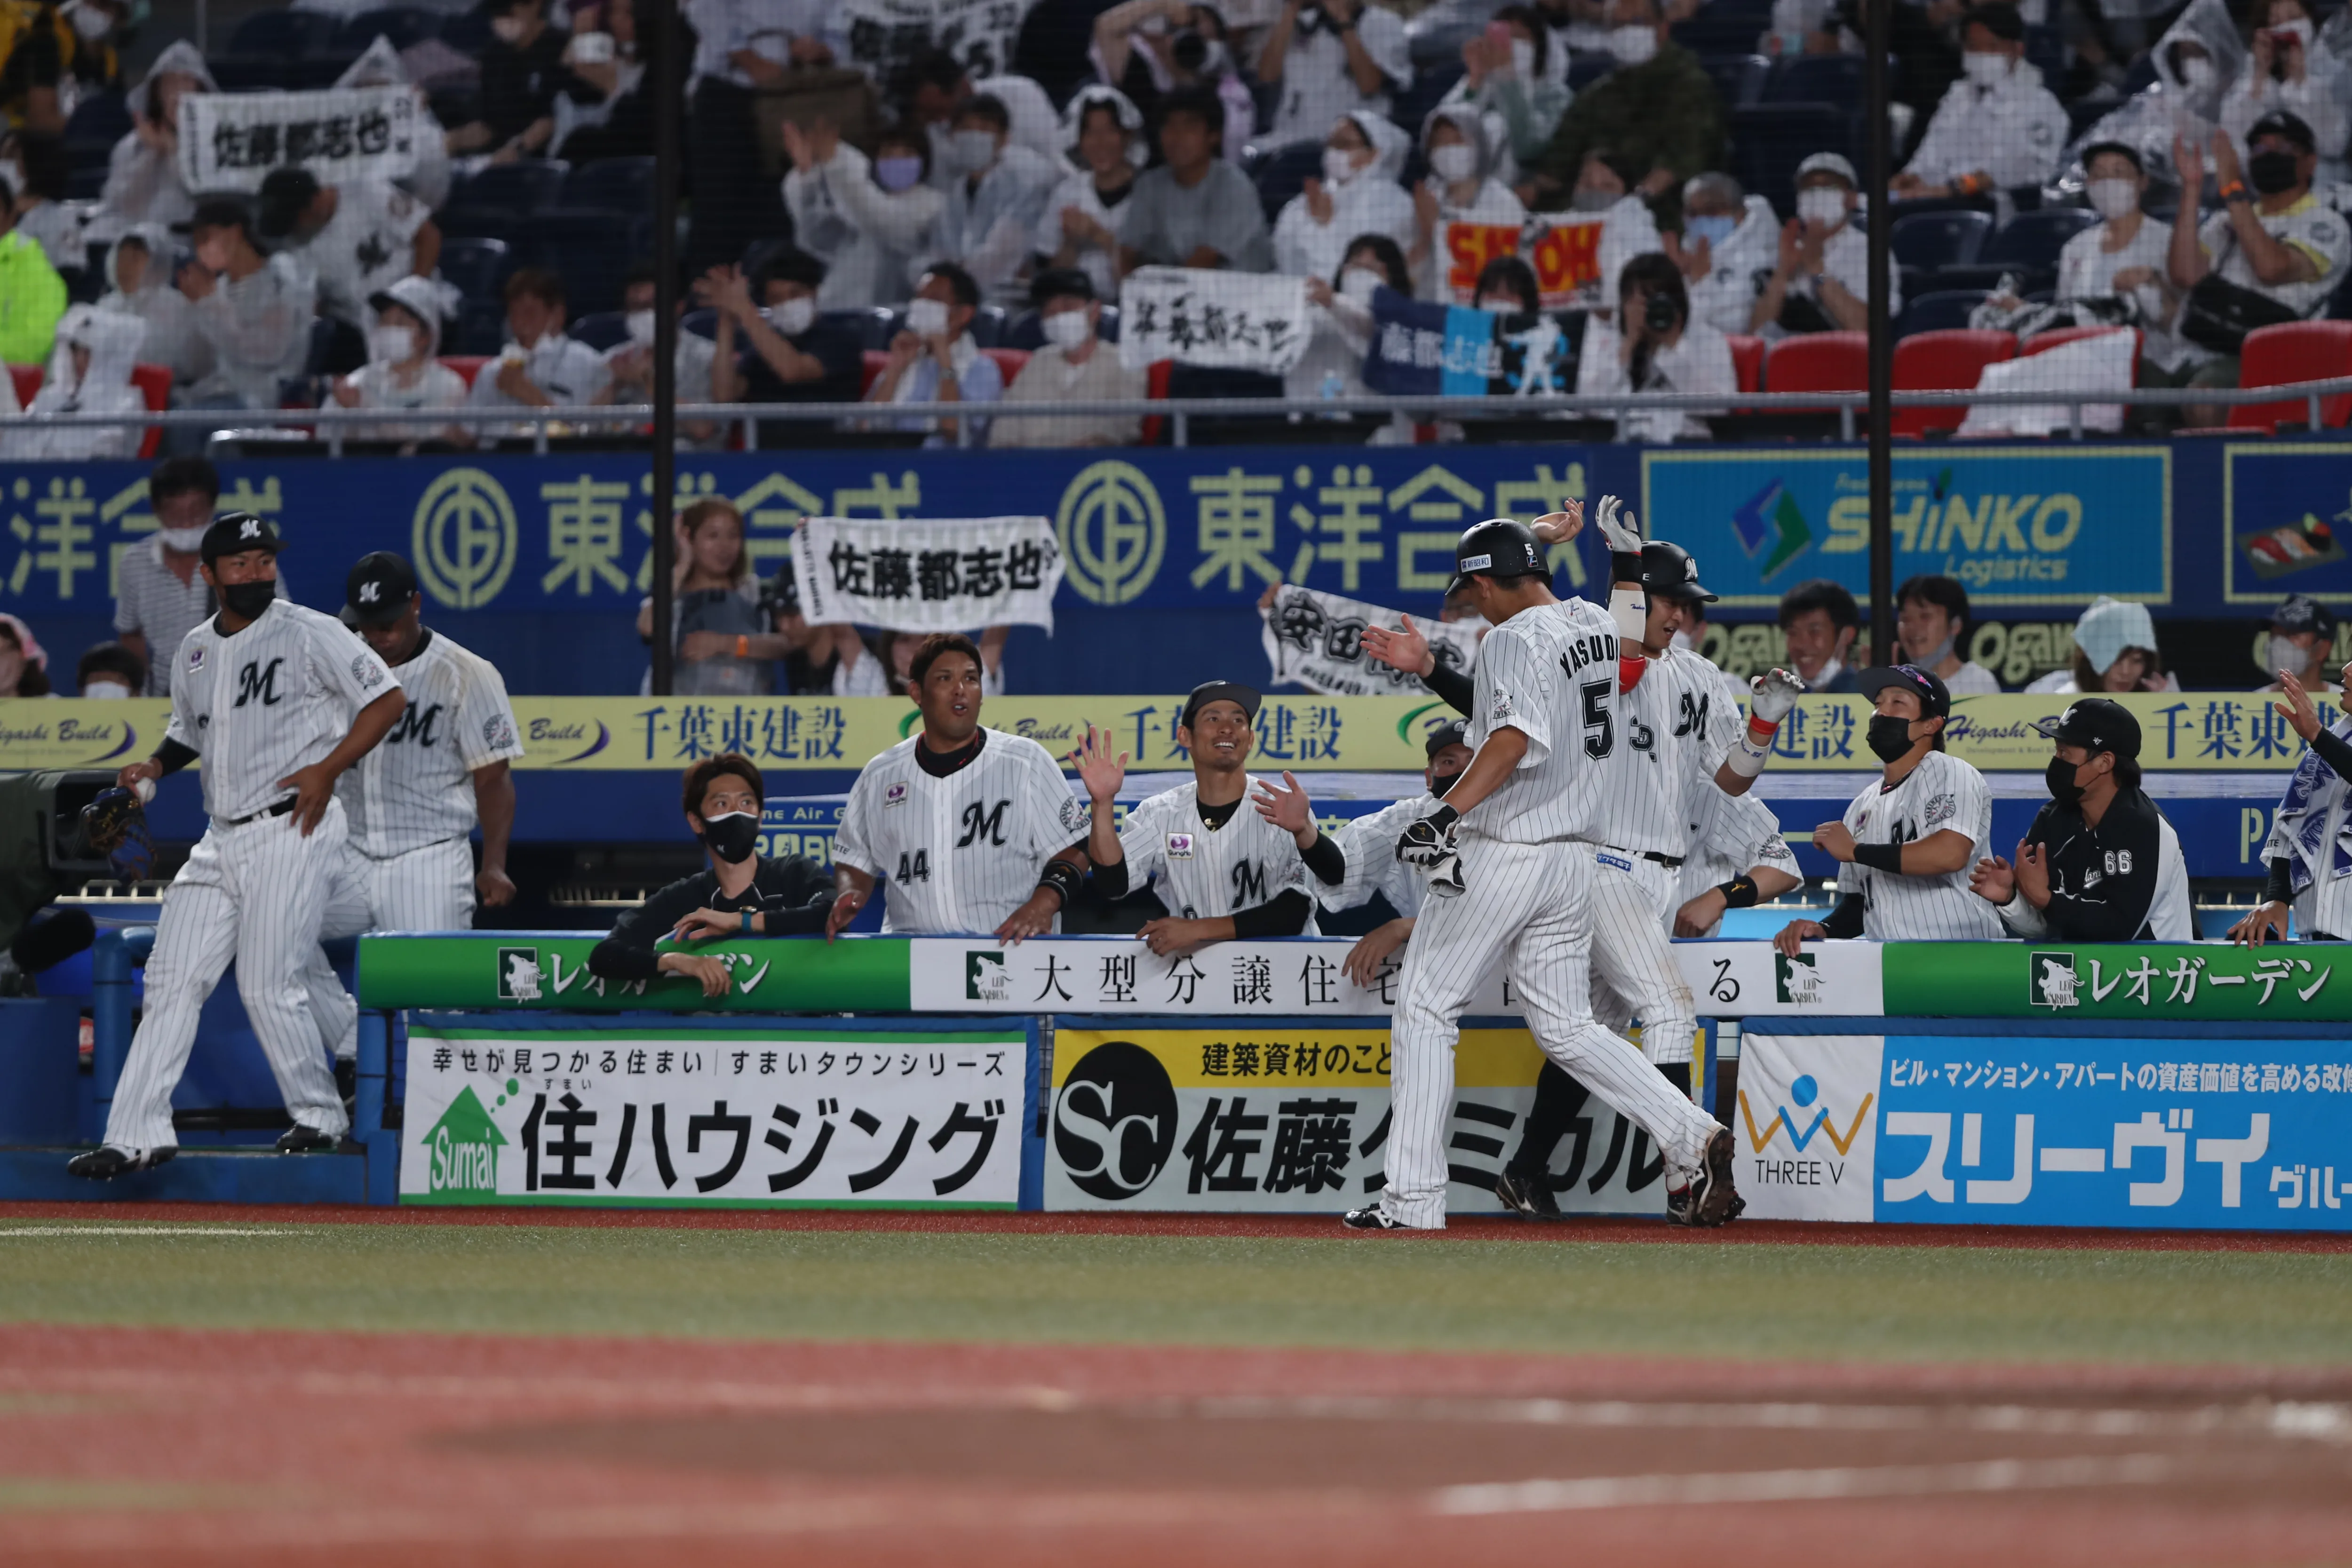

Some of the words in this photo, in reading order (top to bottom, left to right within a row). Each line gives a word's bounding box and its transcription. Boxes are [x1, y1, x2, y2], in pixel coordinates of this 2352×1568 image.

[1467, 557, 1489, 568] 新昭和
[1524, 543, 1534, 556] 5
[828, 539, 1041, 601] 佐藤都志也
[1944, 555, 2068, 587] Logistics
[1559, 634, 1620, 680] YASUD
[530, 717, 586, 741] Build
[633, 704, 846, 761] 千葉東建設
[1014, 718, 1073, 740] Build
[1581, 678, 1614, 761] 5
[1946, 714, 2029, 745] Higashi
[895, 847, 930, 885] 44
[2104, 849, 2132, 875] 66
[1803, 979, 1817, 990] LEO
[2059, 979, 2073, 991] LEO
[2088, 955, 2332, 1006] レオガーデン
[433, 1048, 702, 1075] 幸せが見つかる住まい
[731, 1050, 1006, 1077] すまいタウンシリーズ
[545, 1077, 592, 1090] すまい
[431, 1124, 495, 1191] Sumai
[520, 1091, 1006, 1196] 住ハウジング
[1755, 1160, 1821, 1185] THREE
[1828, 1162, 1844, 1185] V
